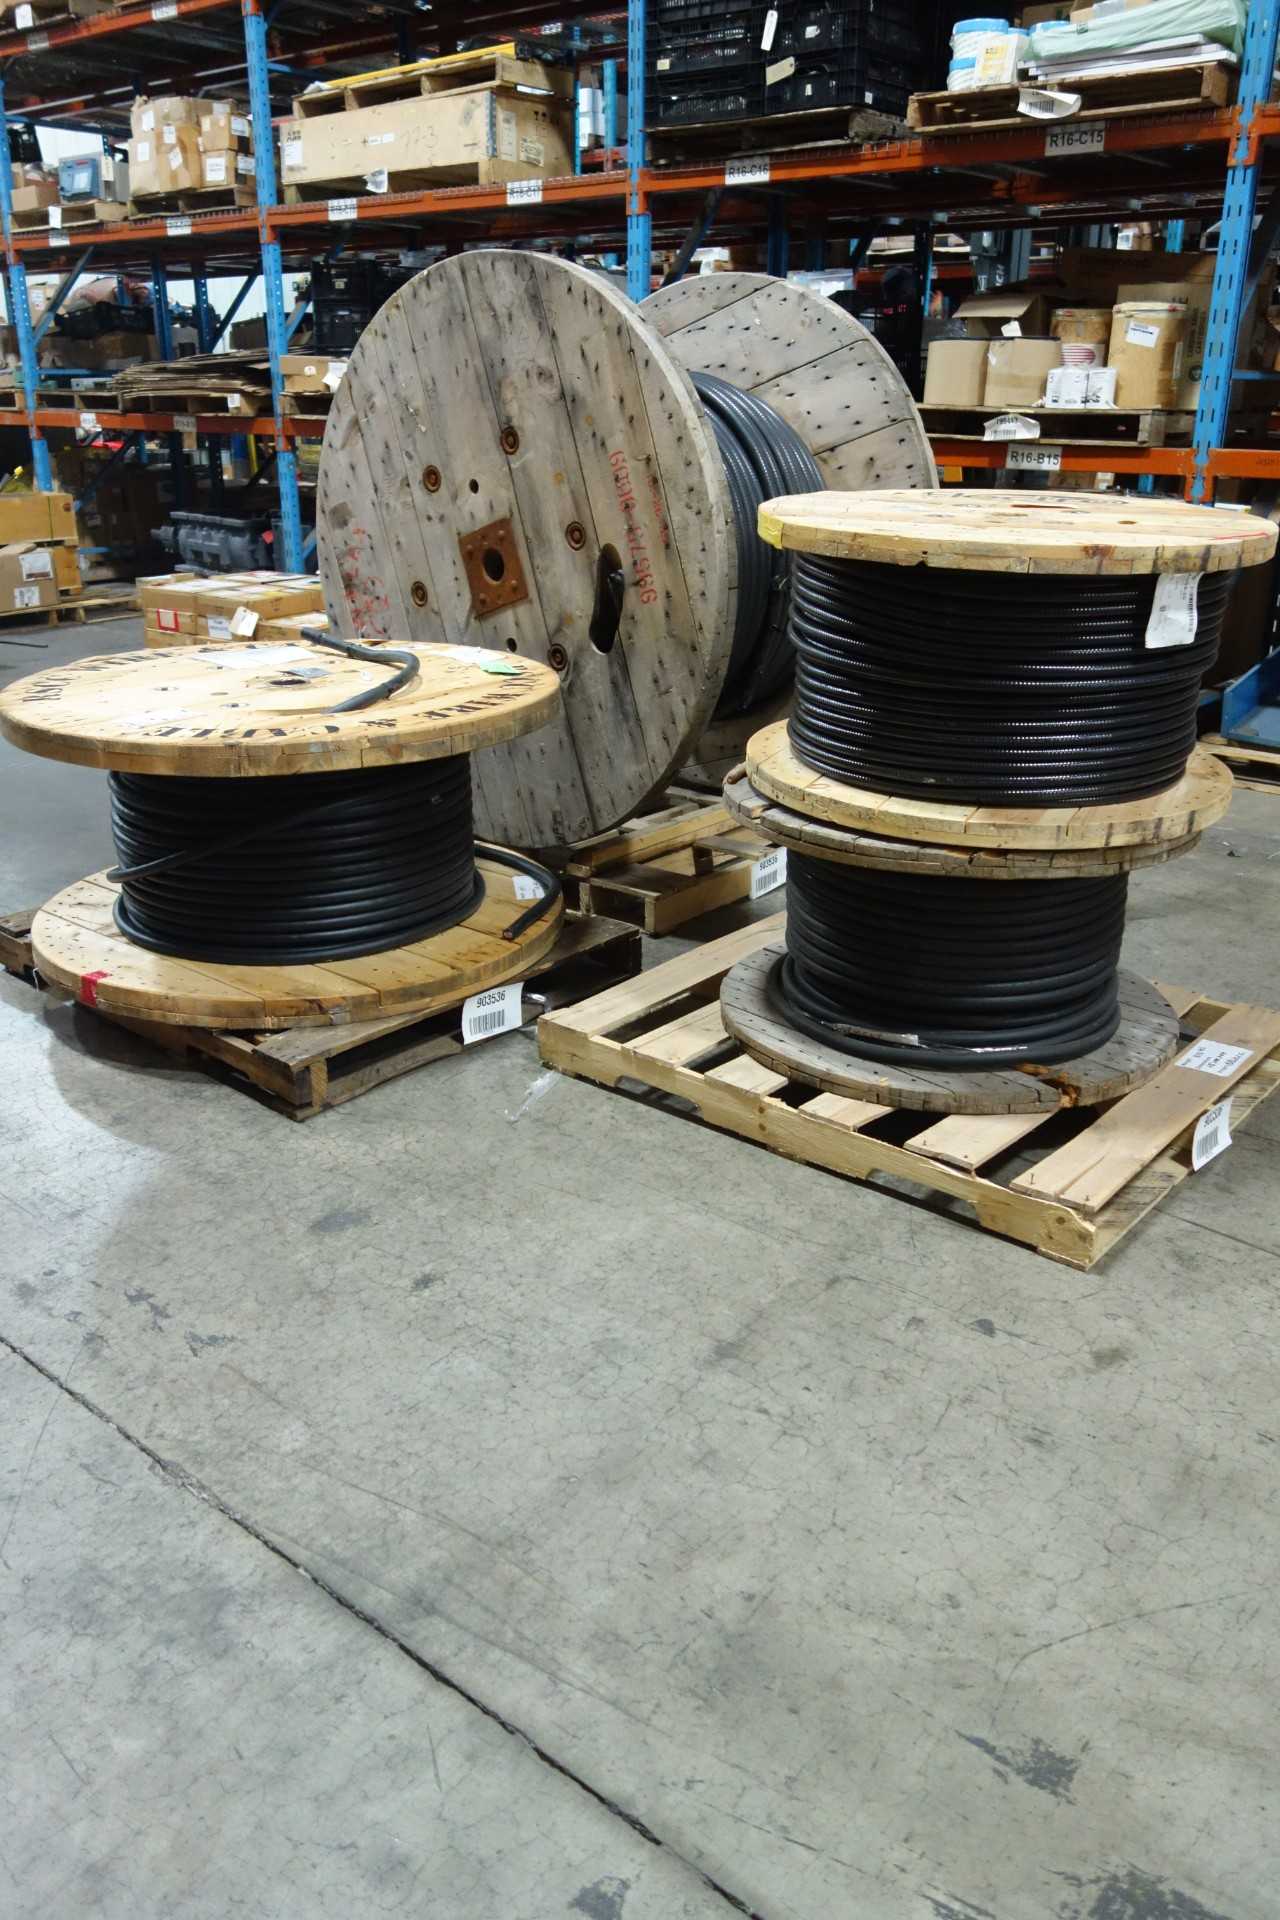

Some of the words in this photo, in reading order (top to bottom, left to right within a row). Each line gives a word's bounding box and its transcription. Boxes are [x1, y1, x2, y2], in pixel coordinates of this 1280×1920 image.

[1049, 131, 1104, 148] R16-C15
[727, 164, 769, 178] R16-C16
[1010, 450, 1060, 465] R16-B15
[476, 990, 506, 1008] 903536
